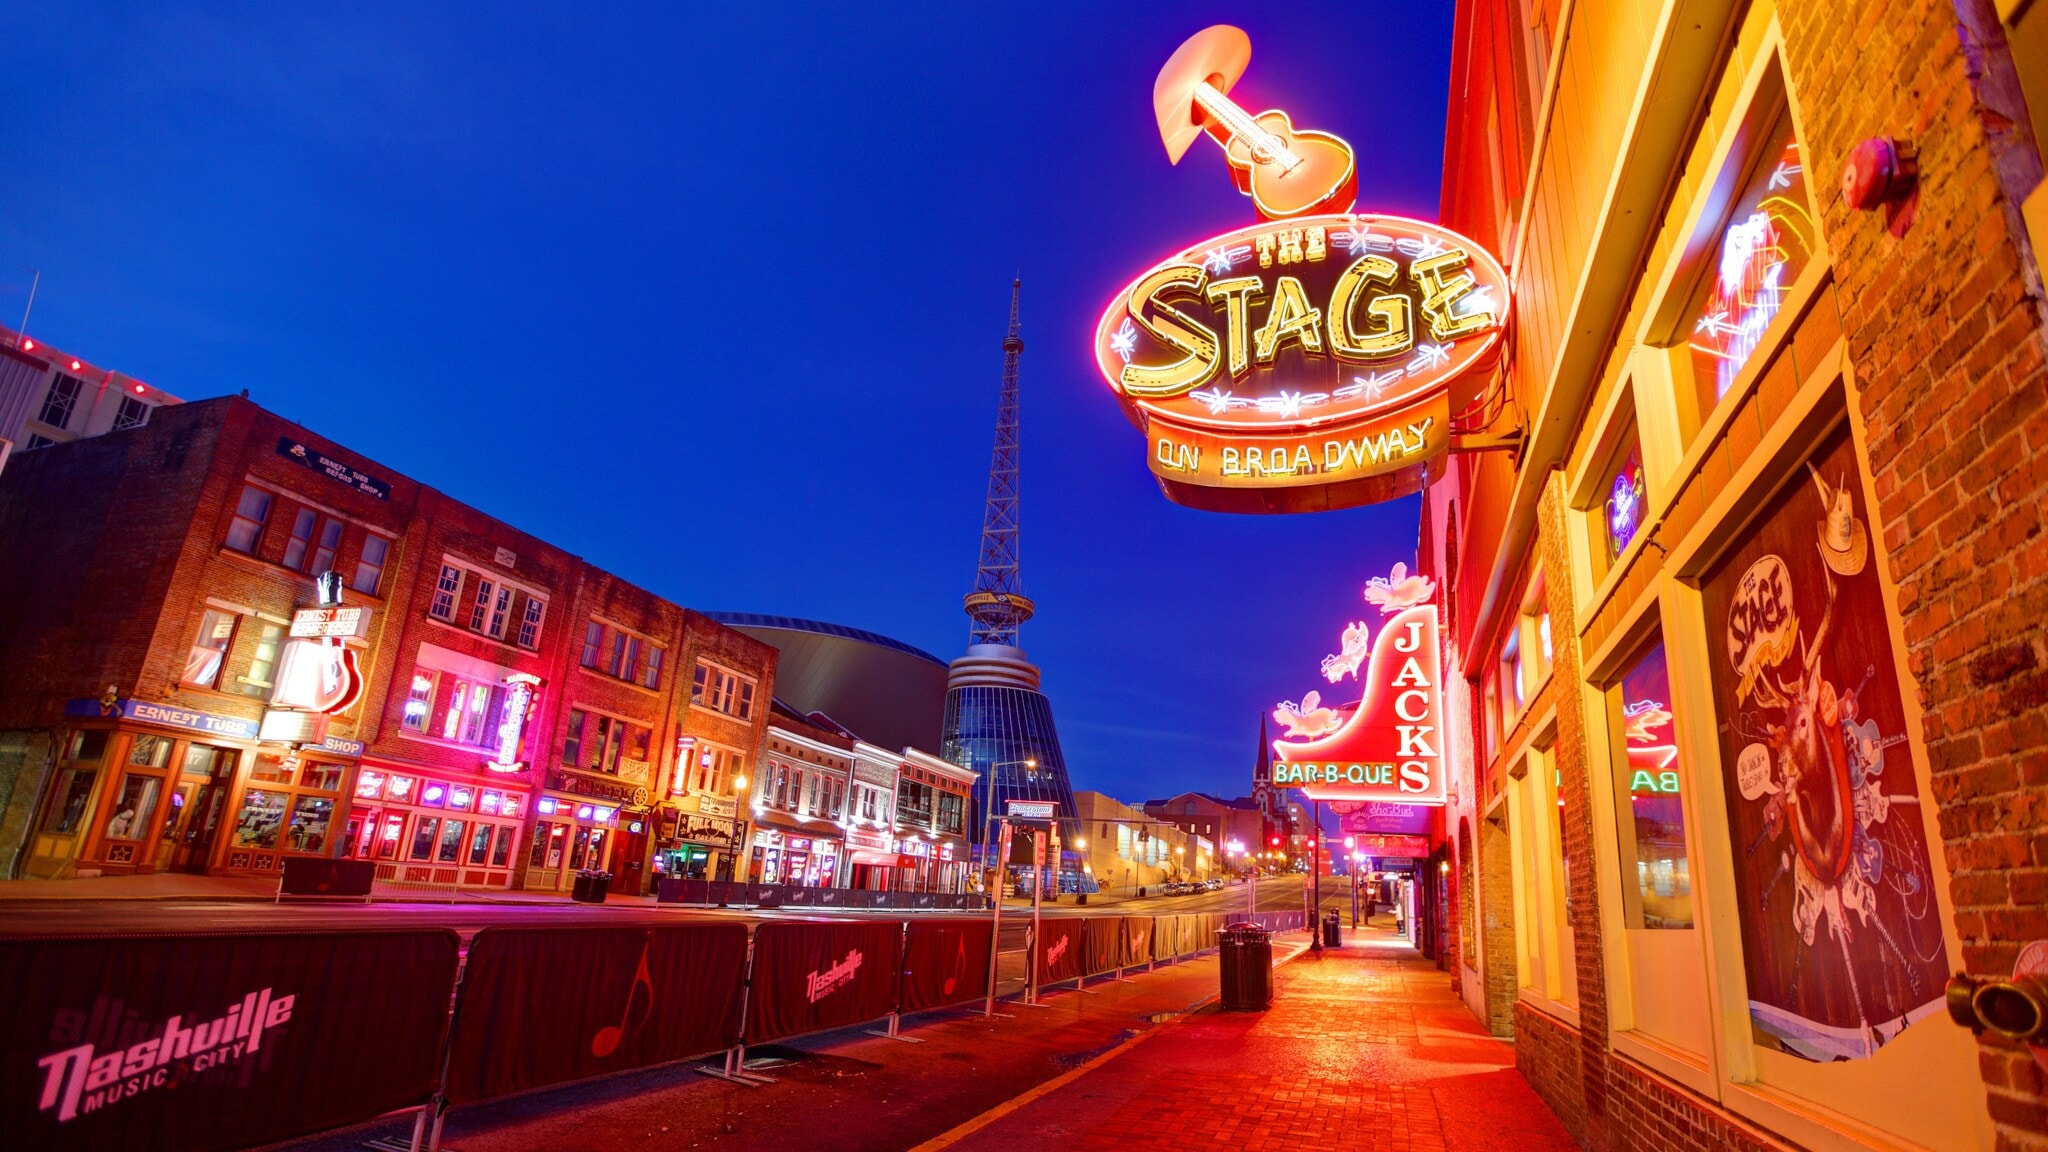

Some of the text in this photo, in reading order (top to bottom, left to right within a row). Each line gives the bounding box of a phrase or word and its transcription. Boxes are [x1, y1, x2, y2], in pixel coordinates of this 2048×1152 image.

[1255, 227, 1327, 268] THE
[1119, 247, 1497, 397] STAGE
[1157, 417, 1433, 478] ON BROADWAY
[320, 456, 369, 484] ERNEST TUBB
[359, 482, 378, 494] SHOP
[1743, 571, 1757, 598] THE
[297, 608, 361, 622] ERNEST TUBB
[1728, 562, 1788, 668] STAGE
[133, 704, 201, 726] ERNEST
[205, 715, 248, 735] TUBB
[1390, 621, 1439, 794] JACKS
[324, 738, 361, 754] SHOP
[1275, 764, 1394, 786] BAR-B-QUE
[686, 815, 711, 834] FULL
[1369, 801, 1415, 818] Sho-Bud
[806, 949, 863, 1004] Nashville
[38, 987, 296, 1123] Nashville
[84, 1041, 247, 1114] MUSIC CITY
